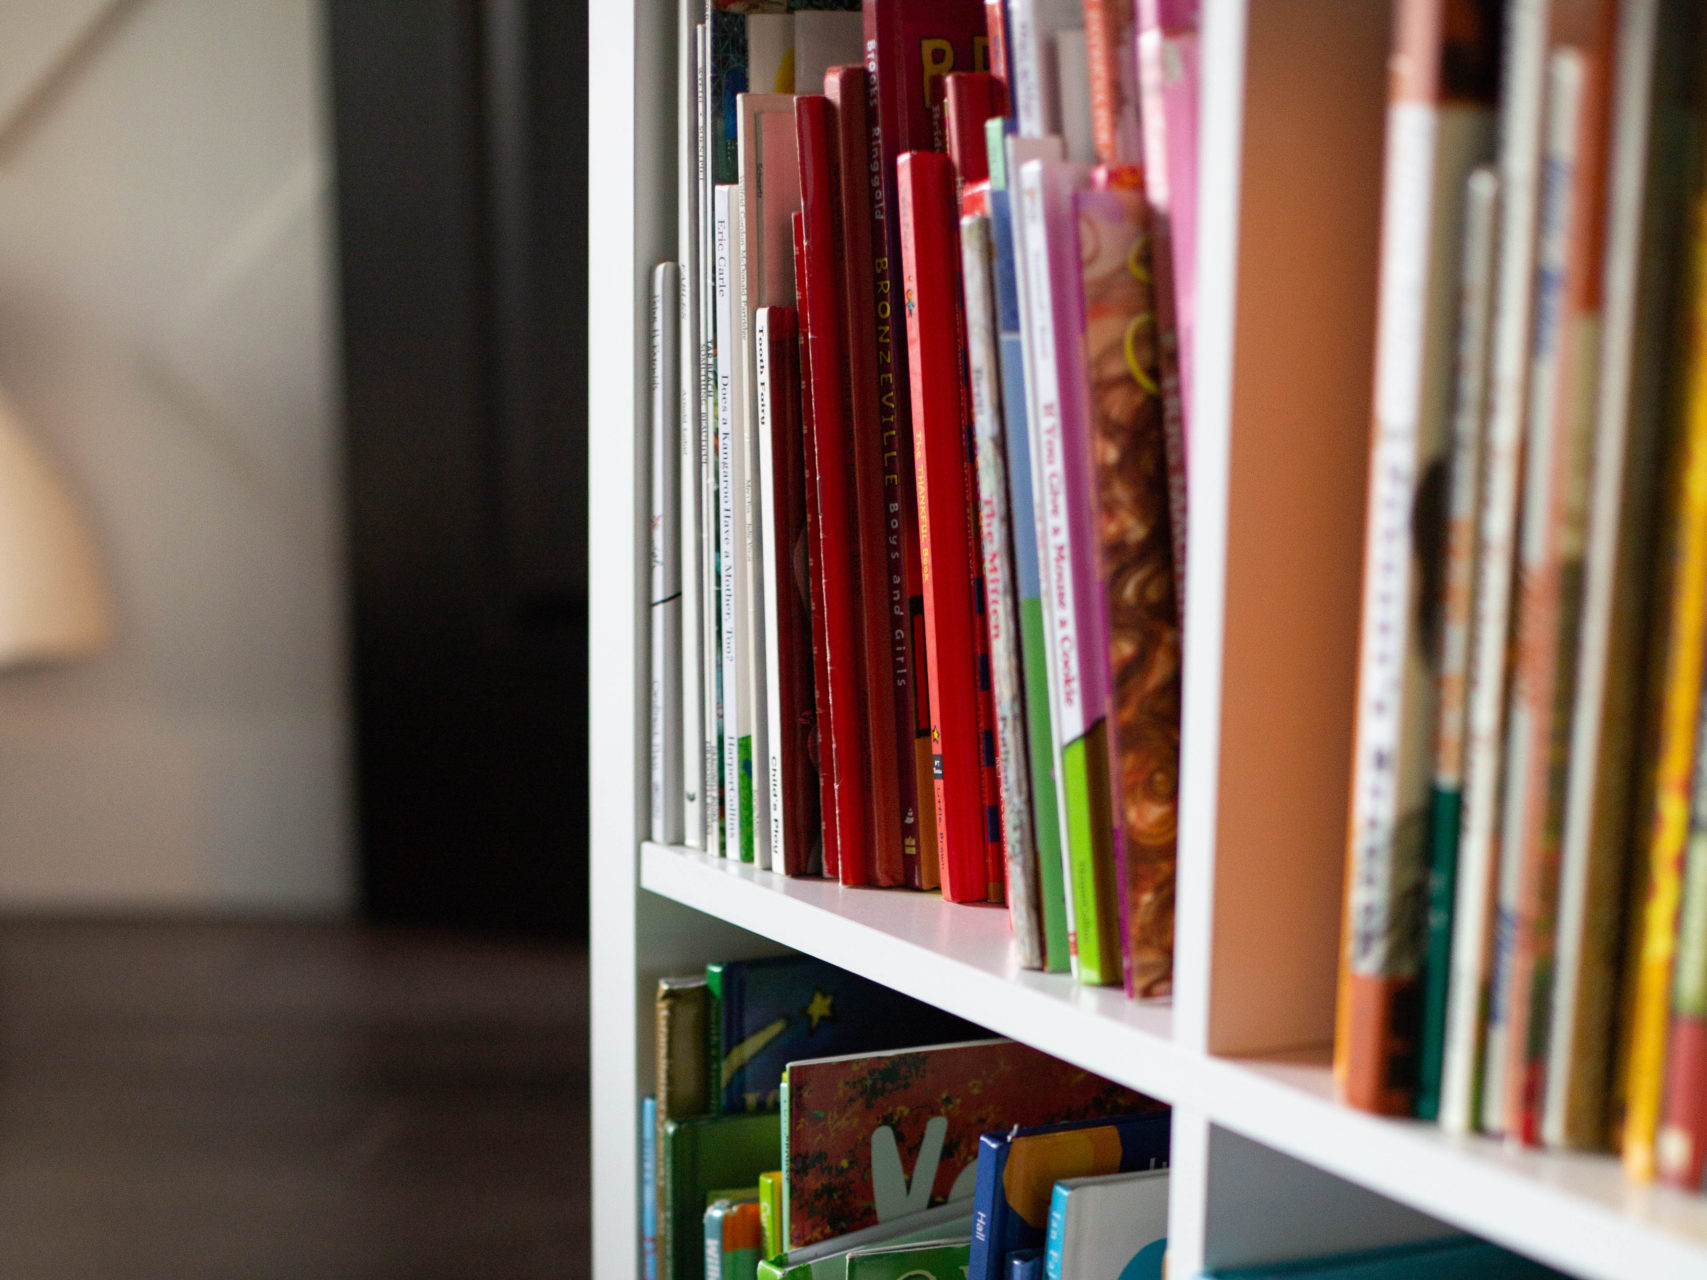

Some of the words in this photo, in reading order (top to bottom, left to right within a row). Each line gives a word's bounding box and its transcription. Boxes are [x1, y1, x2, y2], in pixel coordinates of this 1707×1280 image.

[867, 40, 879, 106] Brooks
[871, 126, 885, 220] Ringgold
[717, 219, 727, 250] Eric
[718, 256, 728, 297] Carle
[758, 326, 766, 375] Tooth
[875, 257, 898, 487] BRONZEVILLE
[721, 375, 730, 412] Does
[759, 381, 767, 426] Fairy
[720, 432, 732, 504] Kangaroo
[915, 431, 923, 460] The
[1044, 424, 1057, 466] You
[917, 464, 929, 542] THANKFUL
[982, 494, 998, 542] The
[1048, 471, 1062, 518] Give
[723, 508, 733, 545] Have
[889, 503, 901, 559] Boys
[922, 548, 930, 583] Book
[1053, 545, 1067, 609] Mouse
[723, 566, 733, 622] Mother,
[892, 575, 904, 616] and
[986, 551, 1001, 639] Mitten
[725, 628, 735, 663] Too?
[896, 629, 908, 687] Girls
[1060, 636, 1077, 708] Cookie
[726, 736, 738, 838] HarperCollins
[770, 756, 779, 812] Child's
[772, 818, 781, 855] Play
[974, 1211, 988, 1241] Hall
